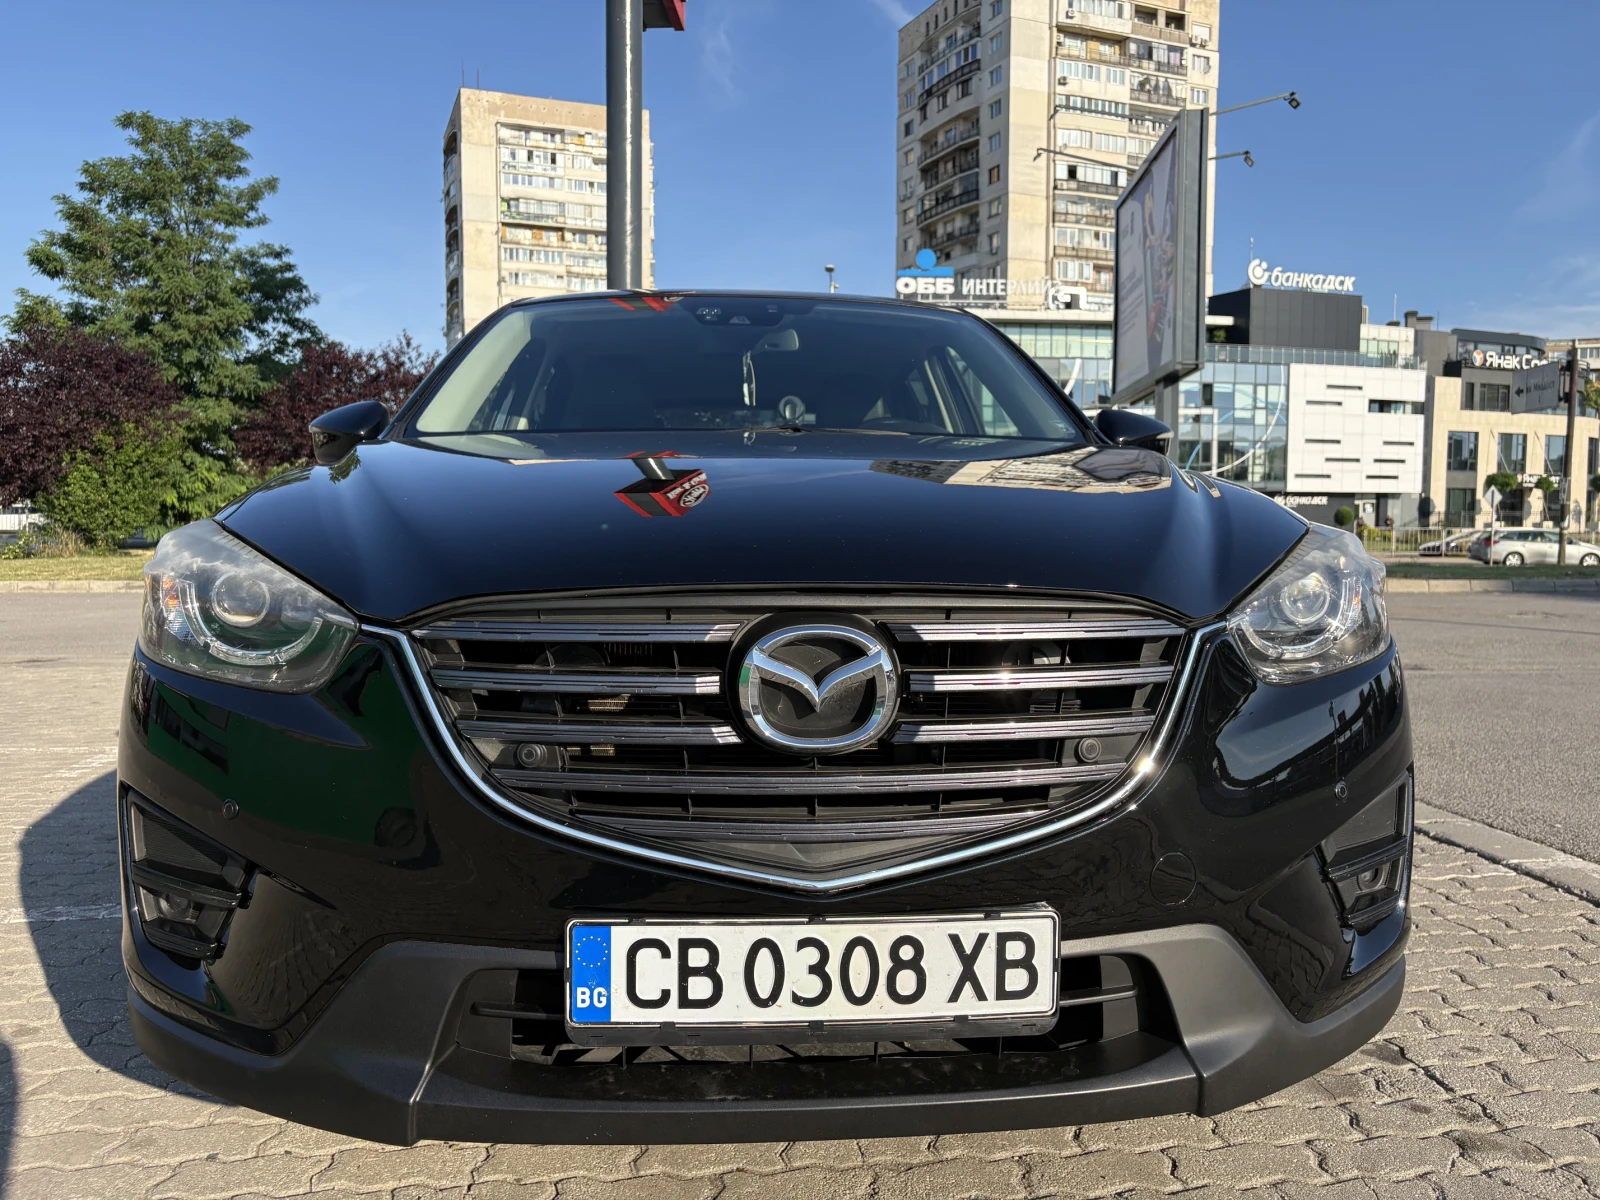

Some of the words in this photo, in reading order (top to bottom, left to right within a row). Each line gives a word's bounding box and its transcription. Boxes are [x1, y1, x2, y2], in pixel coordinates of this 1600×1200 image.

[895, 277, 955, 295] ОББ
[1485, 351, 1520, 370] Янак
[742, 934, 928, 1008] 0308
[576, 987, 608, 1008] BG
